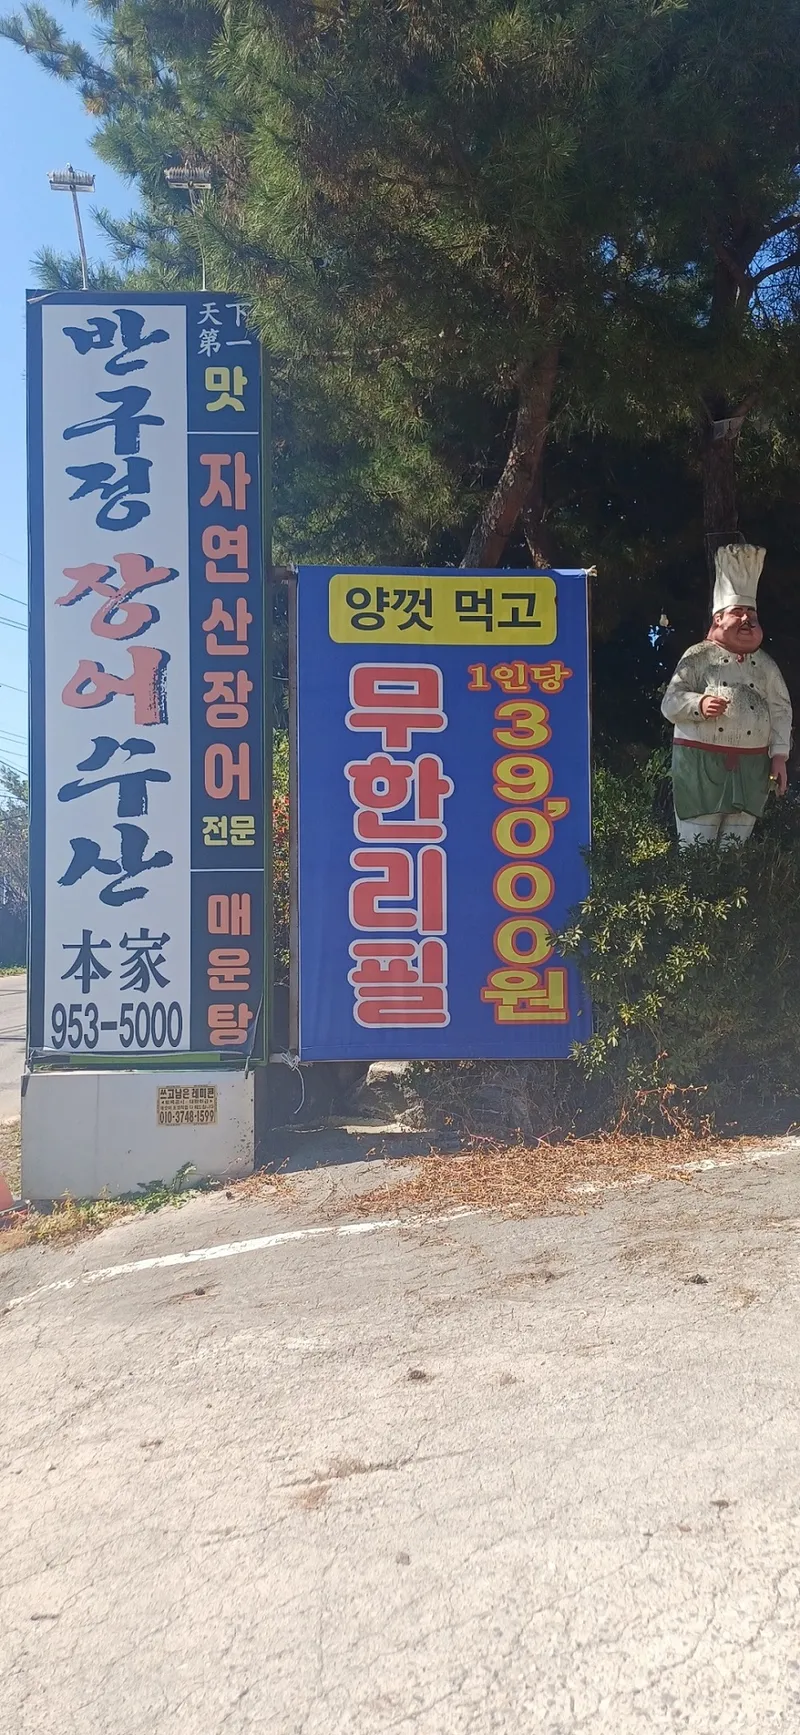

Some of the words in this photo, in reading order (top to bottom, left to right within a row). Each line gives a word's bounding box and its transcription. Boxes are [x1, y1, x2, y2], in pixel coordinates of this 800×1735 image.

[197, 328, 251, 357] 第一
[205, 366, 248, 412] 맛
[62, 308, 170, 531] 반구정
[199, 451, 253, 801] 자연산장어
[346, 587, 433, 632] 양껏
[455, 588, 542, 632] 먹고
[467, 660, 573, 694] 1인당
[202, 815, 256, 847] 전문
[344, 661, 454, 1028] 무한리필
[480, 698, 570, 1025] 39,000원
[61, 928, 171, 994] 本家
[206, 892, 253, 1046] 매운탕
[51, 1001, 183, 1049] 953-5000
[160, 1088, 190, 1099] 쓰고남은
